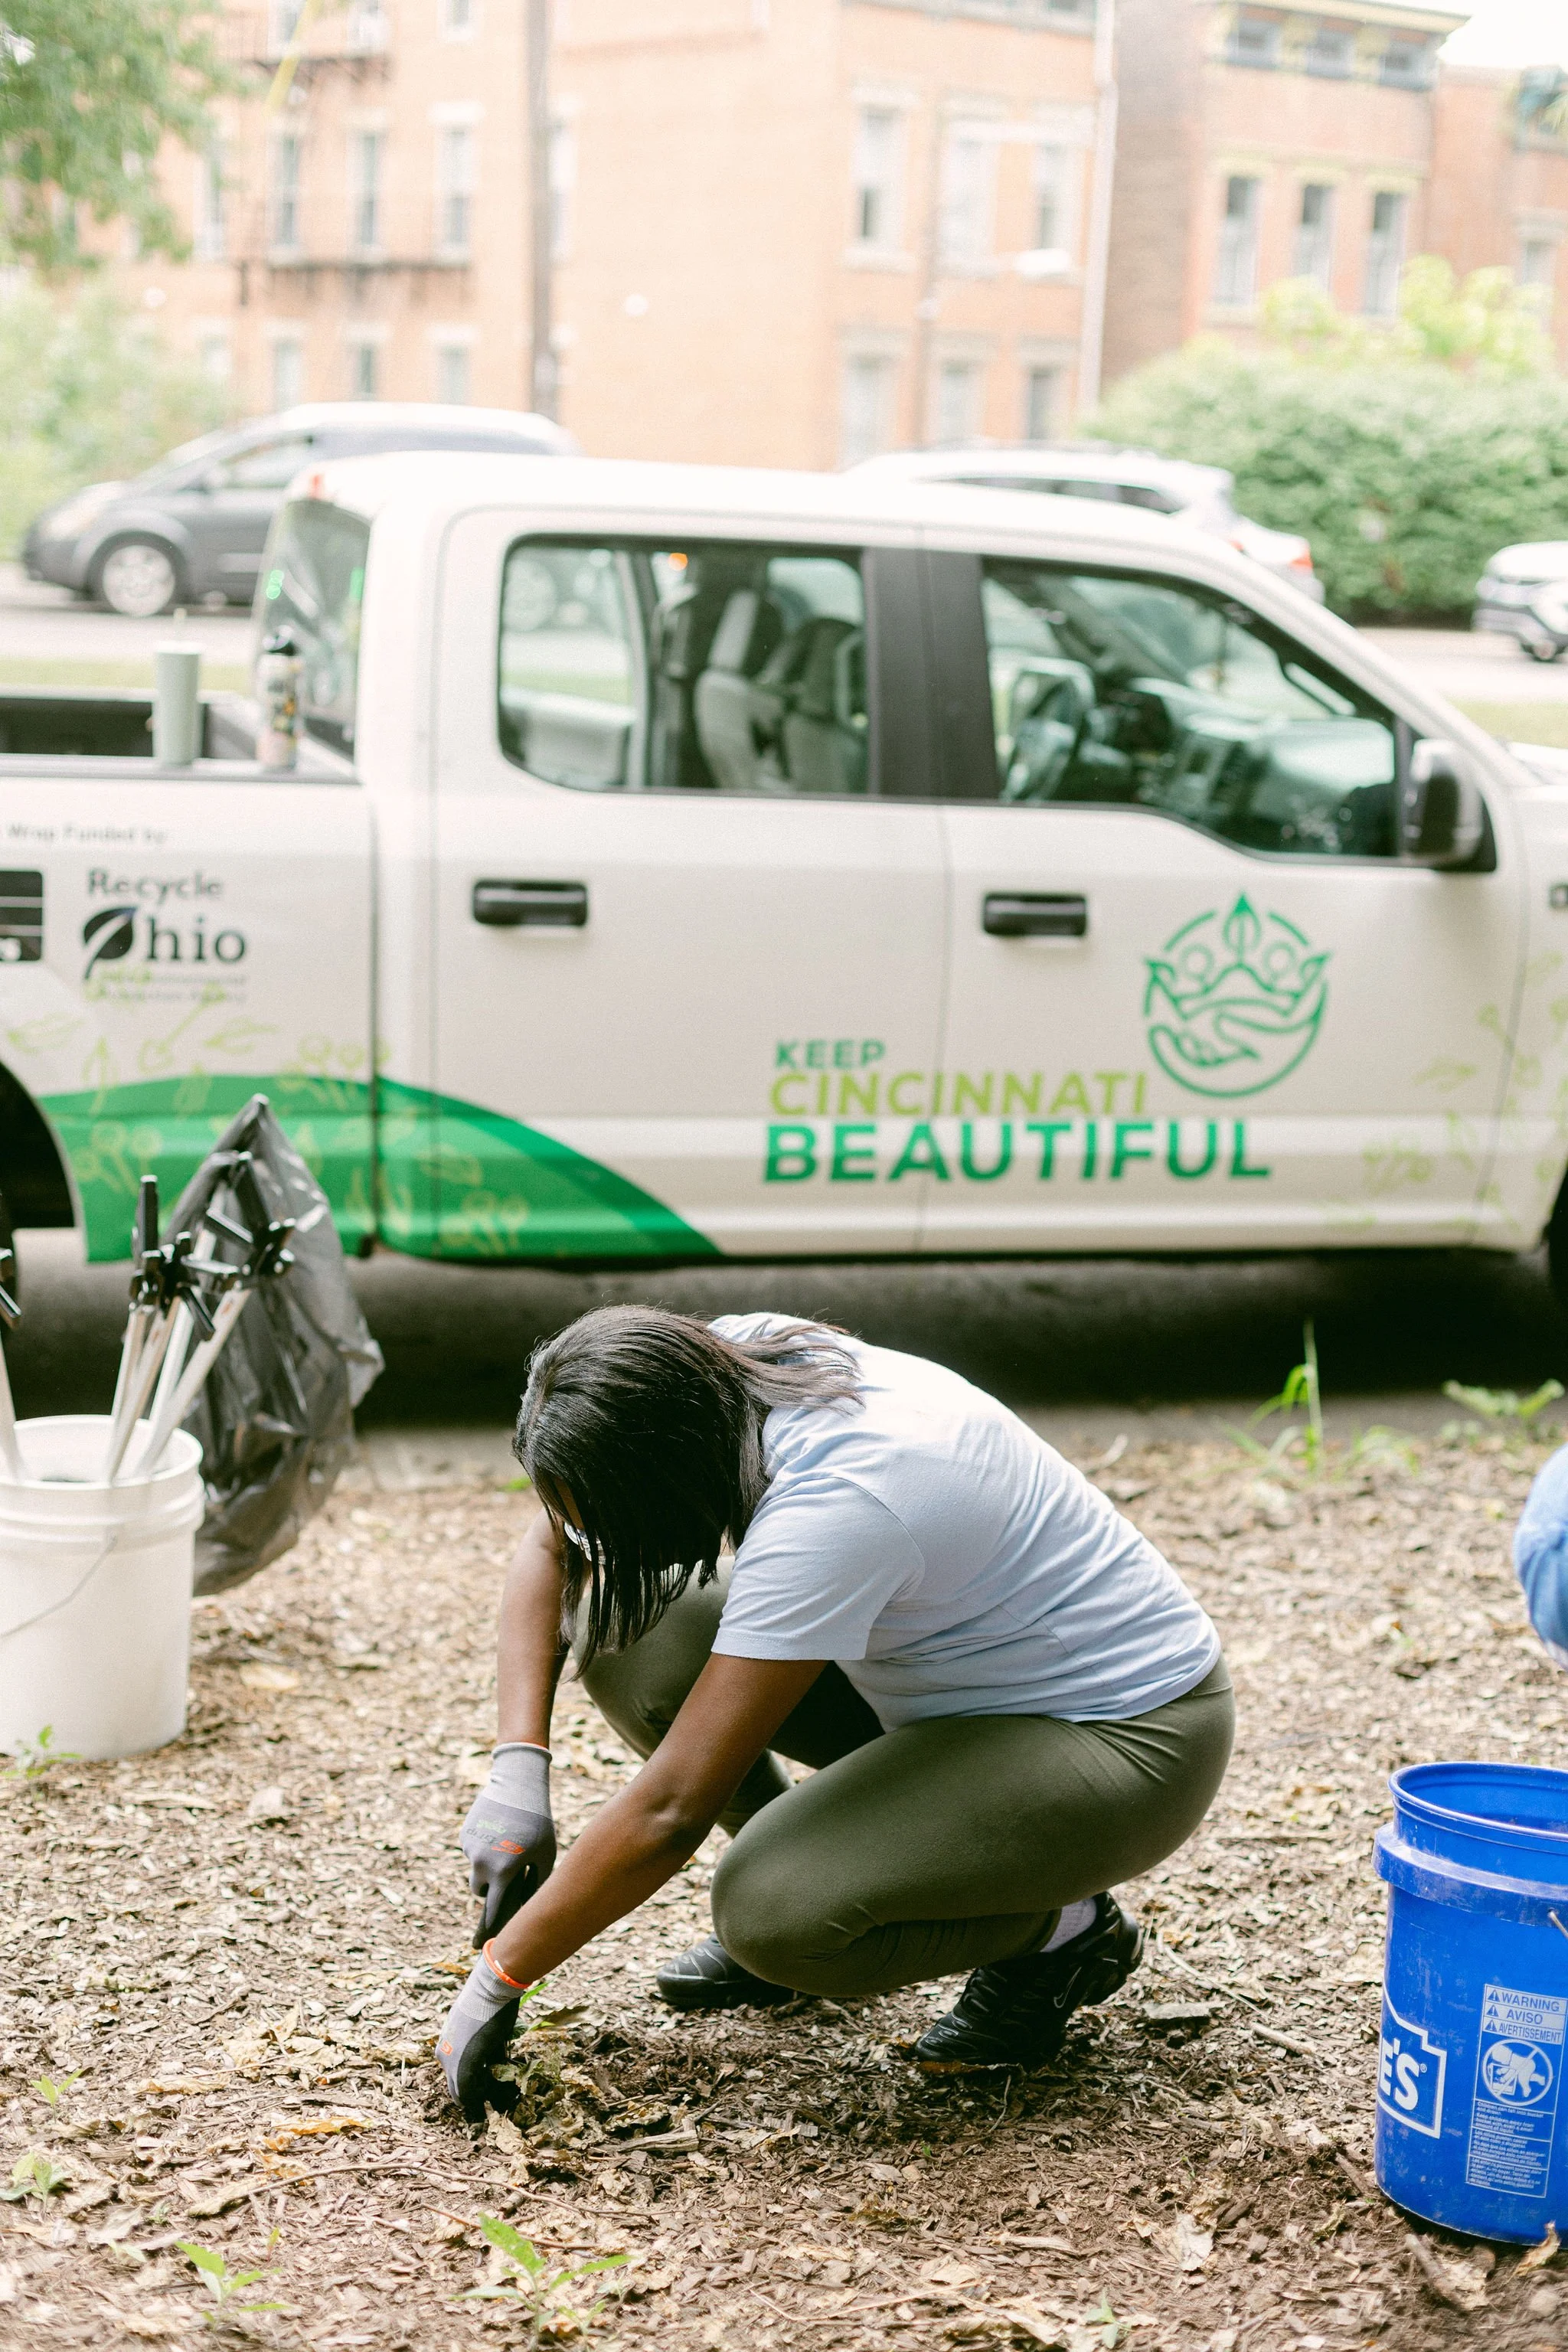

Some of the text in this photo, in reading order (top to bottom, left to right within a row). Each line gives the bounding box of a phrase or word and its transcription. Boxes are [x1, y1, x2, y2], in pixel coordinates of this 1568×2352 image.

[87, 869, 222, 904] Recycle
[775, 1040, 884, 1069] KEEP
[770, 1072, 1145, 1116] CINCINNATI
[764, 1120, 1271, 1183] BEAUTIFUL
[1501, 1992, 1560, 2012] WARNING
[1506, 2008, 1543, 2024] AVISO
[1499, 2023, 1561, 2043] AVERTISSEMENT
